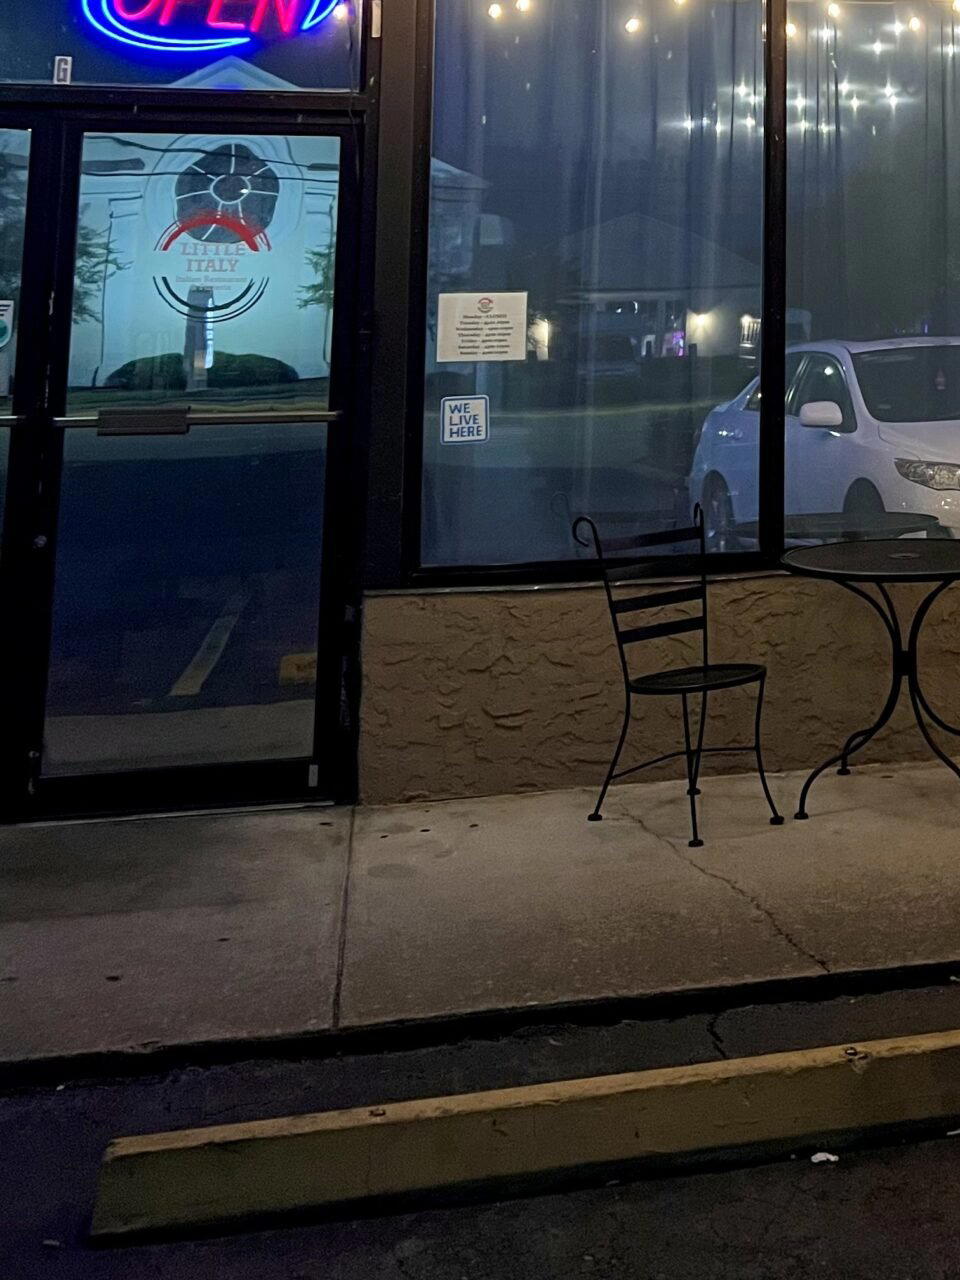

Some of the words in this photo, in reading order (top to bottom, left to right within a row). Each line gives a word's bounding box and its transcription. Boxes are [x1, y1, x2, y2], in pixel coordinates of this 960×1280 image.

[56, 58, 69, 82] G
[180, 242, 246, 256] LITTLE
[187, 258, 240, 273] ITALY
[449, 402, 471, 414] WE
[449, 414, 480, 426] LIVE
[449, 425, 483, 438] HERE
